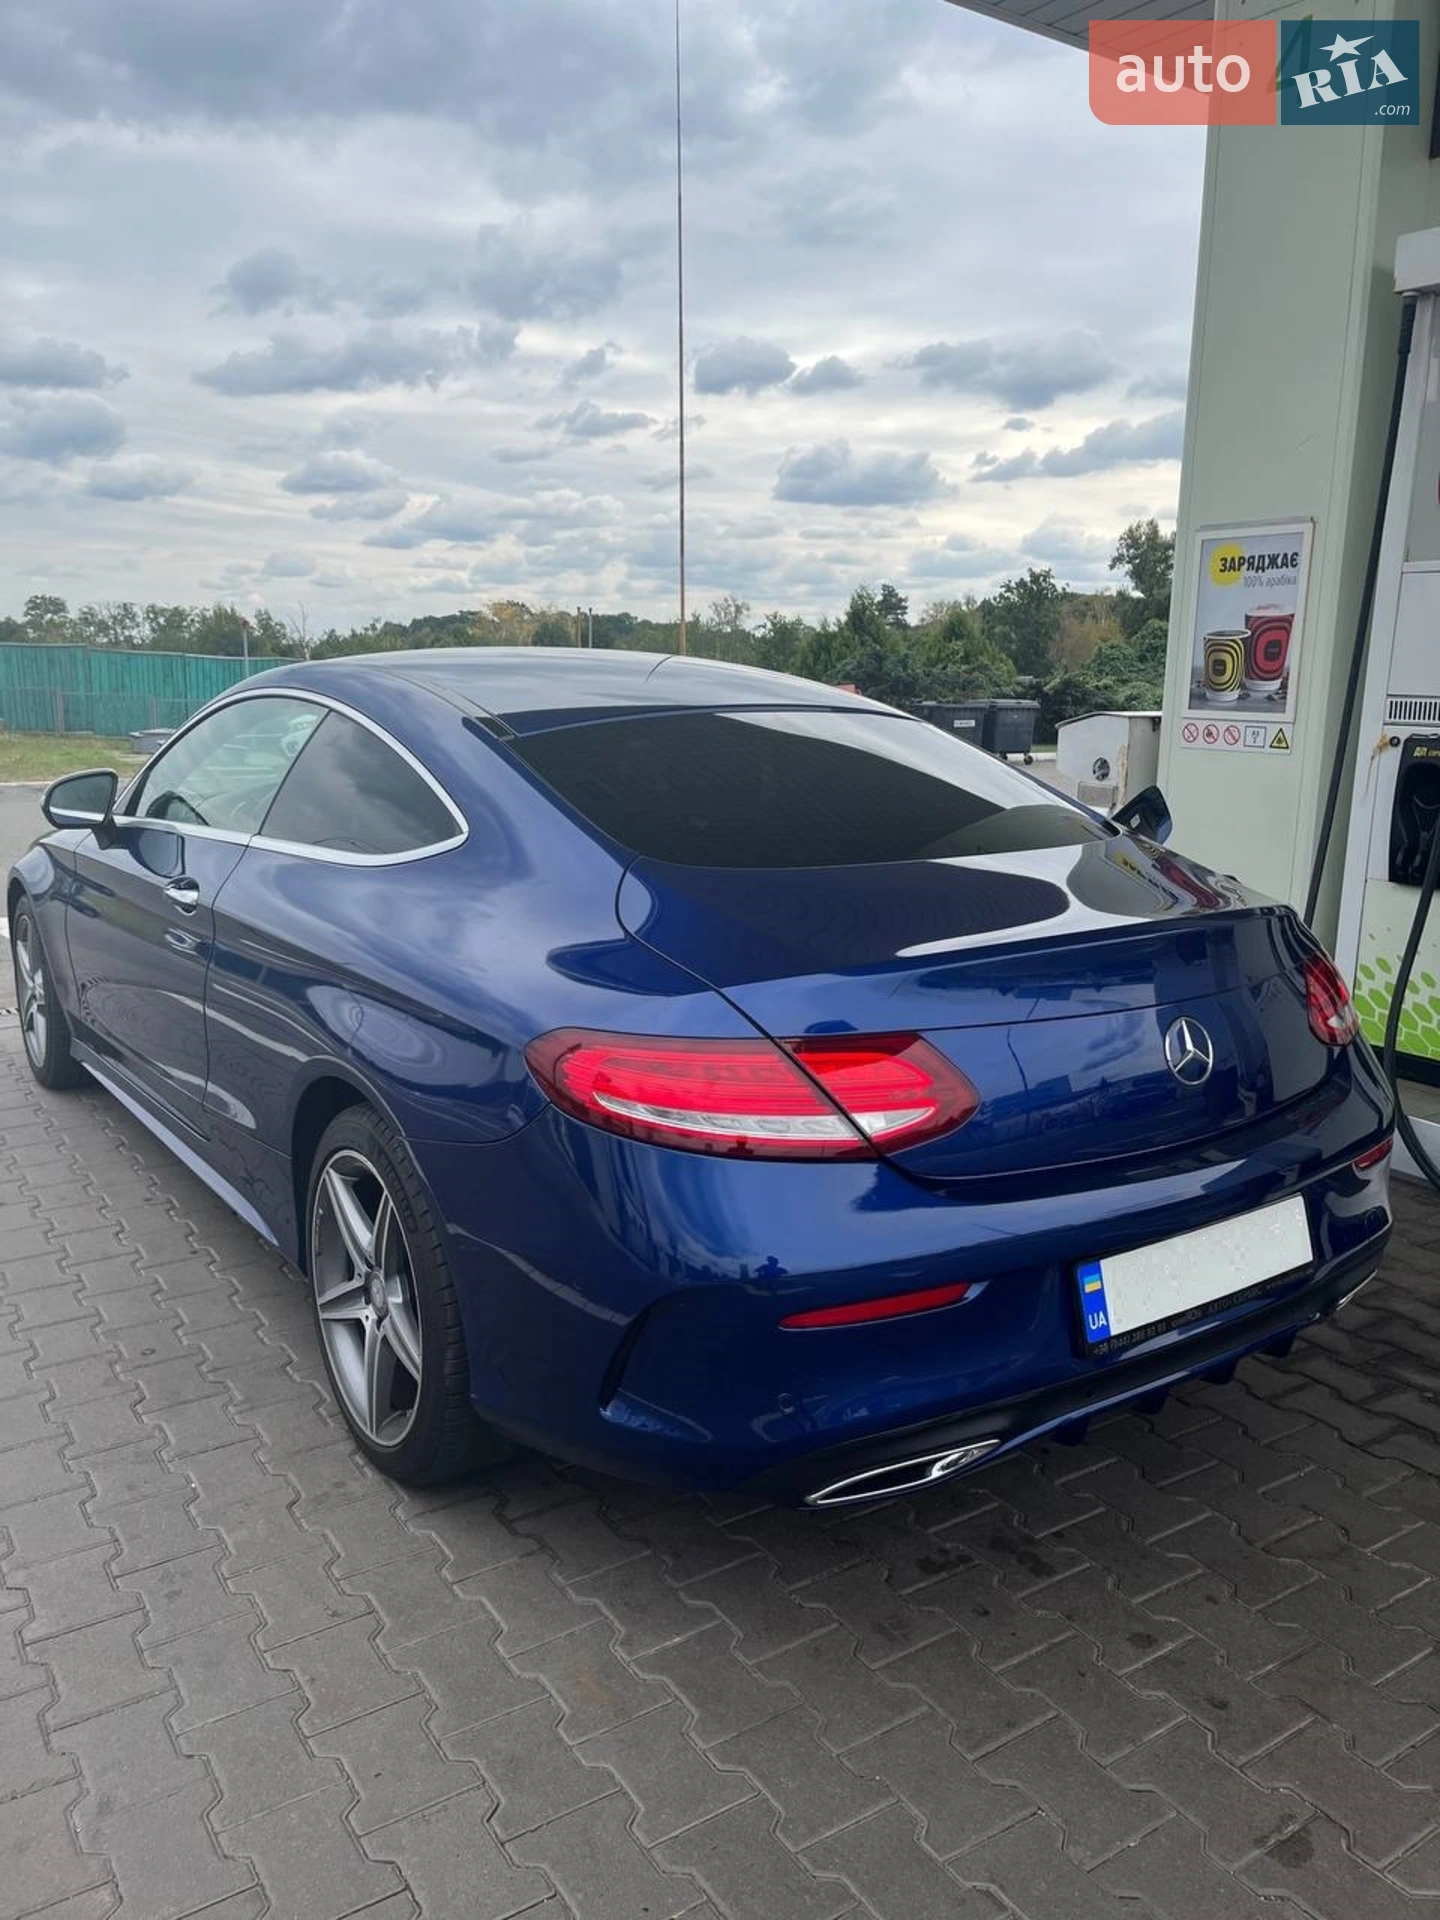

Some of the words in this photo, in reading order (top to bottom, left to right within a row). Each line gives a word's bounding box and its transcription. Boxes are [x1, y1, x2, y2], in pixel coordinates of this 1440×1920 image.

[1219, 552, 1299, 573] ЗАРЯДЖАЄ
[1243, 575, 1263, 588] 100%
[1265, 574, 1297, 588] арабіка
[1089, 1312, 1107, 1330] UA
